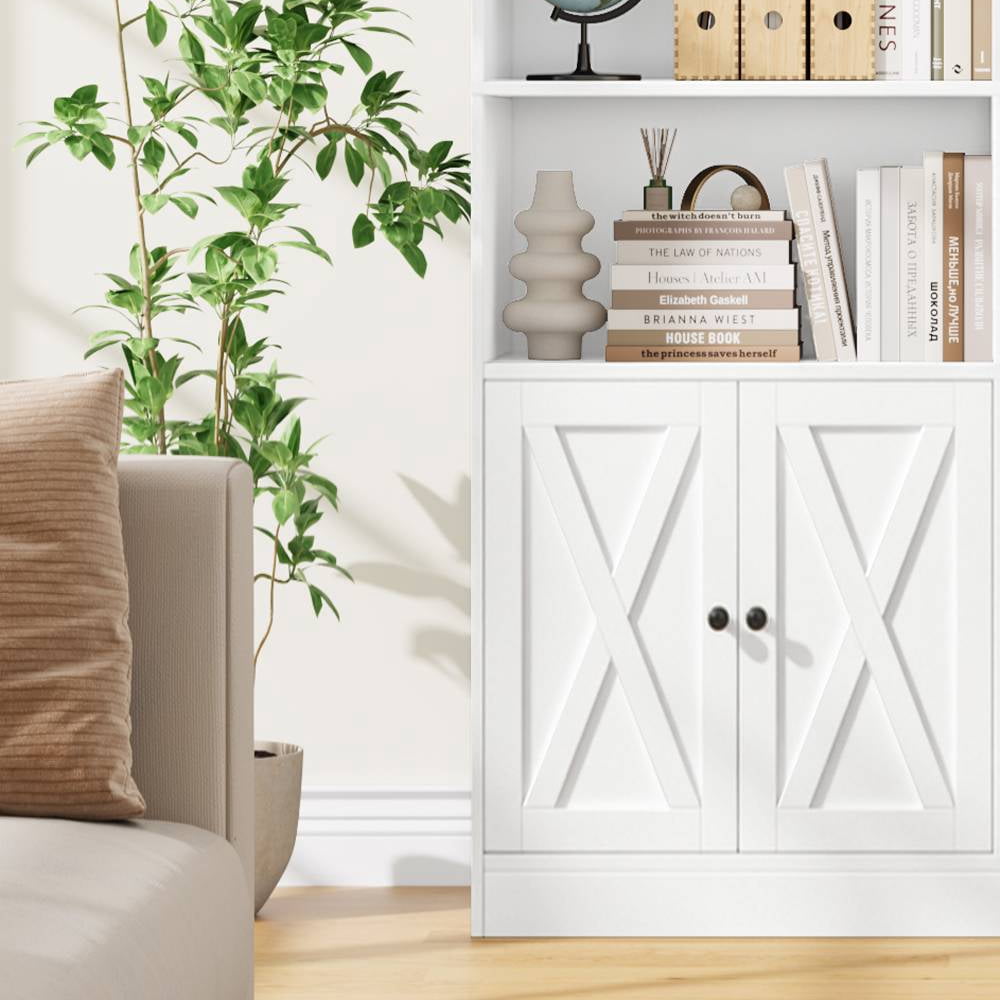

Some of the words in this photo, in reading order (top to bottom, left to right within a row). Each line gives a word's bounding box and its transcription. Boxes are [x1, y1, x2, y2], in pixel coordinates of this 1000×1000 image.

[636, 226, 692, 234] PHOTOGRAPHS
[694, 226, 703, 234] BY
[907, 201, 918, 246] ЗАБОТА
[822, 230, 834, 254] Метод
[649, 248, 670, 257] THE
[674, 248, 695, 257] LAW
[700, 248, 712, 257] OF
[716, 248, 762, 257] NATIONS
[907, 250, 918, 260] О
[648, 271, 690, 284] Houses
[698, 271, 739, 284] Atelier
[825, 256, 840, 304] управления
[660, 294, 707, 305] Elizabeth
[710, 294, 748, 305] Gaskell
[907, 262, 918, 338] ПРЕДАННЫХ
[930, 282, 938, 342] ШОКОЛАД
[644, 314, 708, 324] BRIANNA
[715, 314, 756, 324] WIEST
[948, 304, 960, 344] ЛУЧШЕ
[666, 332, 704, 344] HOUSE
[708, 332, 740, 344] BOOK
